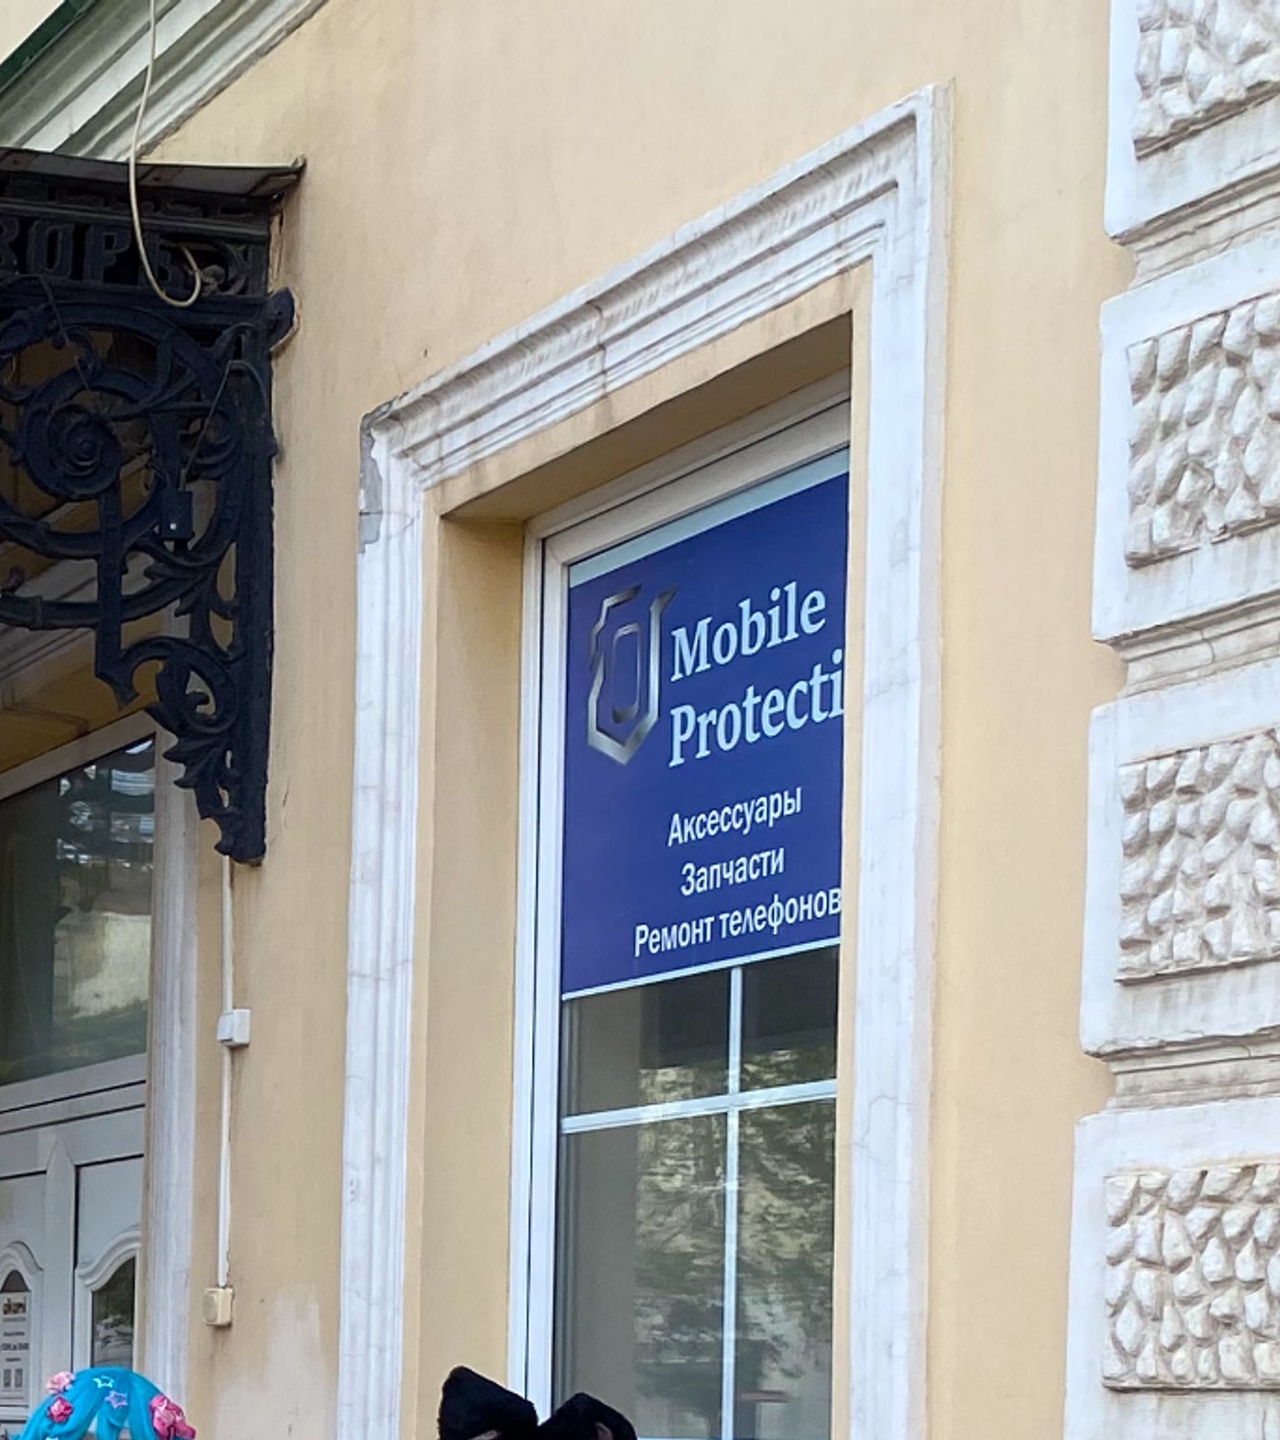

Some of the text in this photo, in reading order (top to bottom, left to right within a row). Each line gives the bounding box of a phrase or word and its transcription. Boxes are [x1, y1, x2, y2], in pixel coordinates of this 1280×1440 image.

[670, 580, 826, 683] Mobile
[668, 648, 843, 768] Protecti
[667, 786, 803, 849] Аксессуары
[679, 843, 786, 898] Запчасти
[634, 884, 842, 958] Ремонт телефонов
